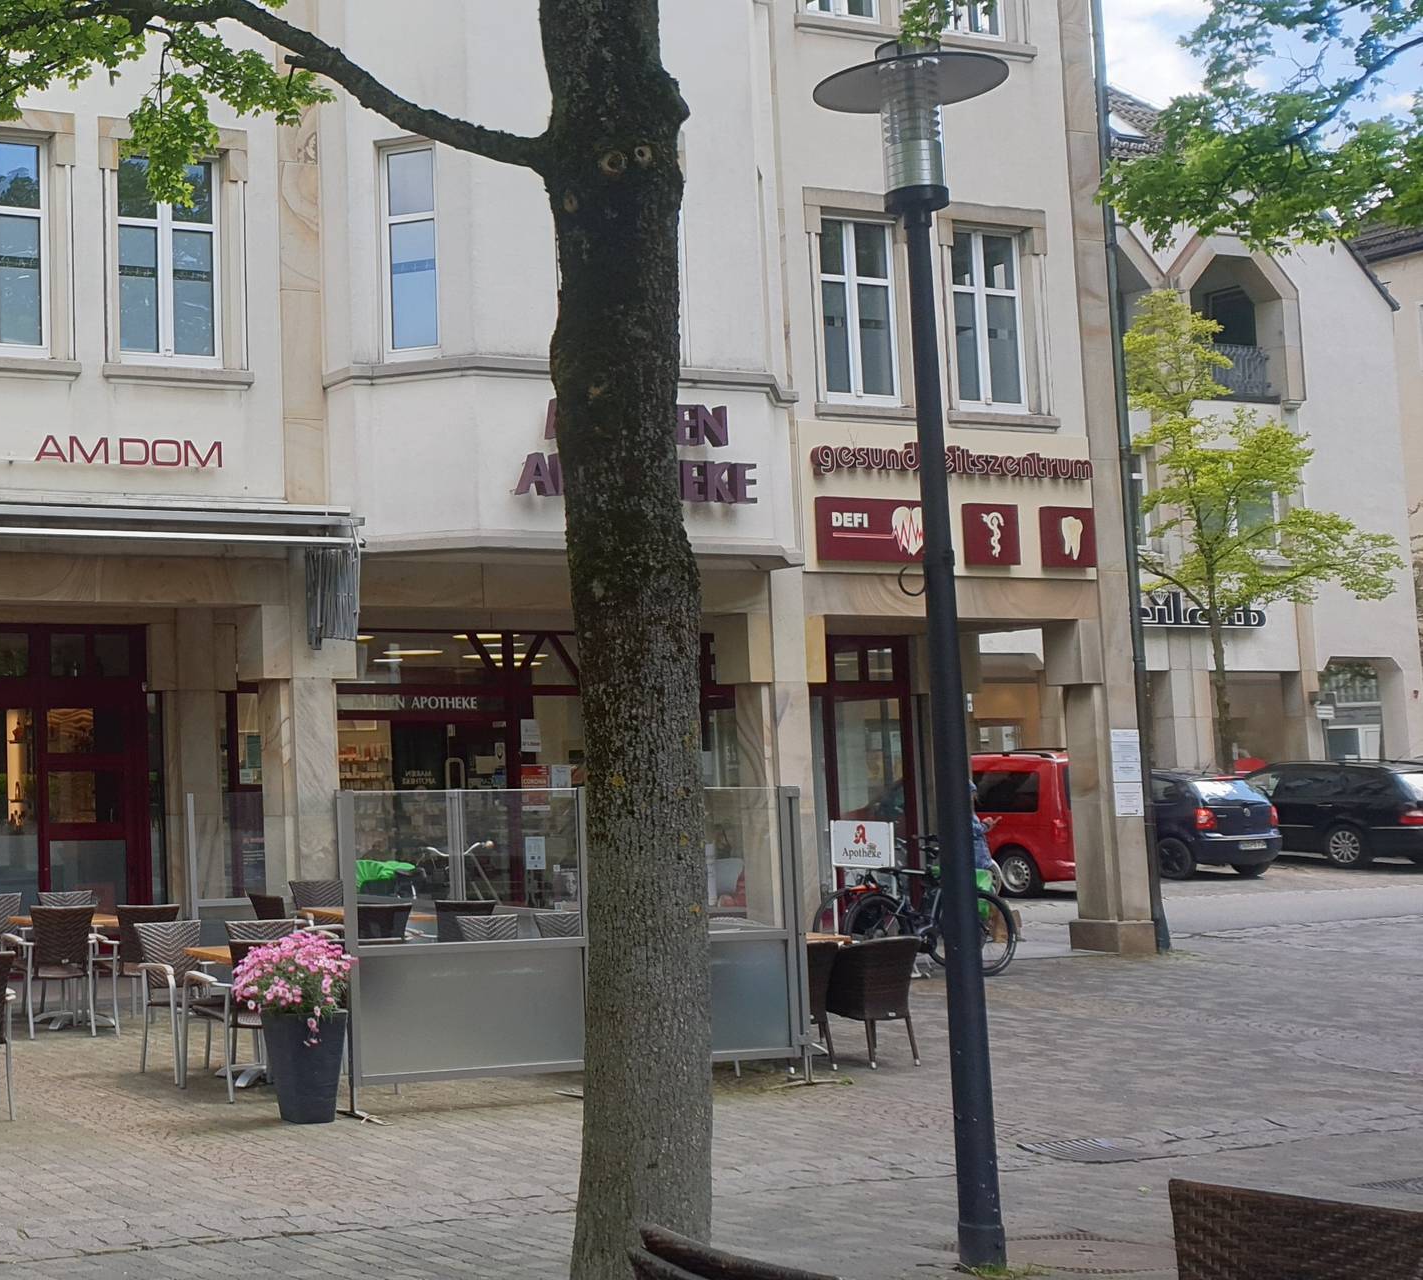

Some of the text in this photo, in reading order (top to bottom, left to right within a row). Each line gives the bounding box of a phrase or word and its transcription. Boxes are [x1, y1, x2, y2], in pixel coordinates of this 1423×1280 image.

[34, 434, 109, 464] AM
[119, 437, 222, 468] DOM
[811, 441, 1093, 479] gesundeitszentrum
[831, 511, 869, 528] DEFI
[411, 695, 478, 710] APOTHEKE
[841, 847, 882, 860] Apotheke
